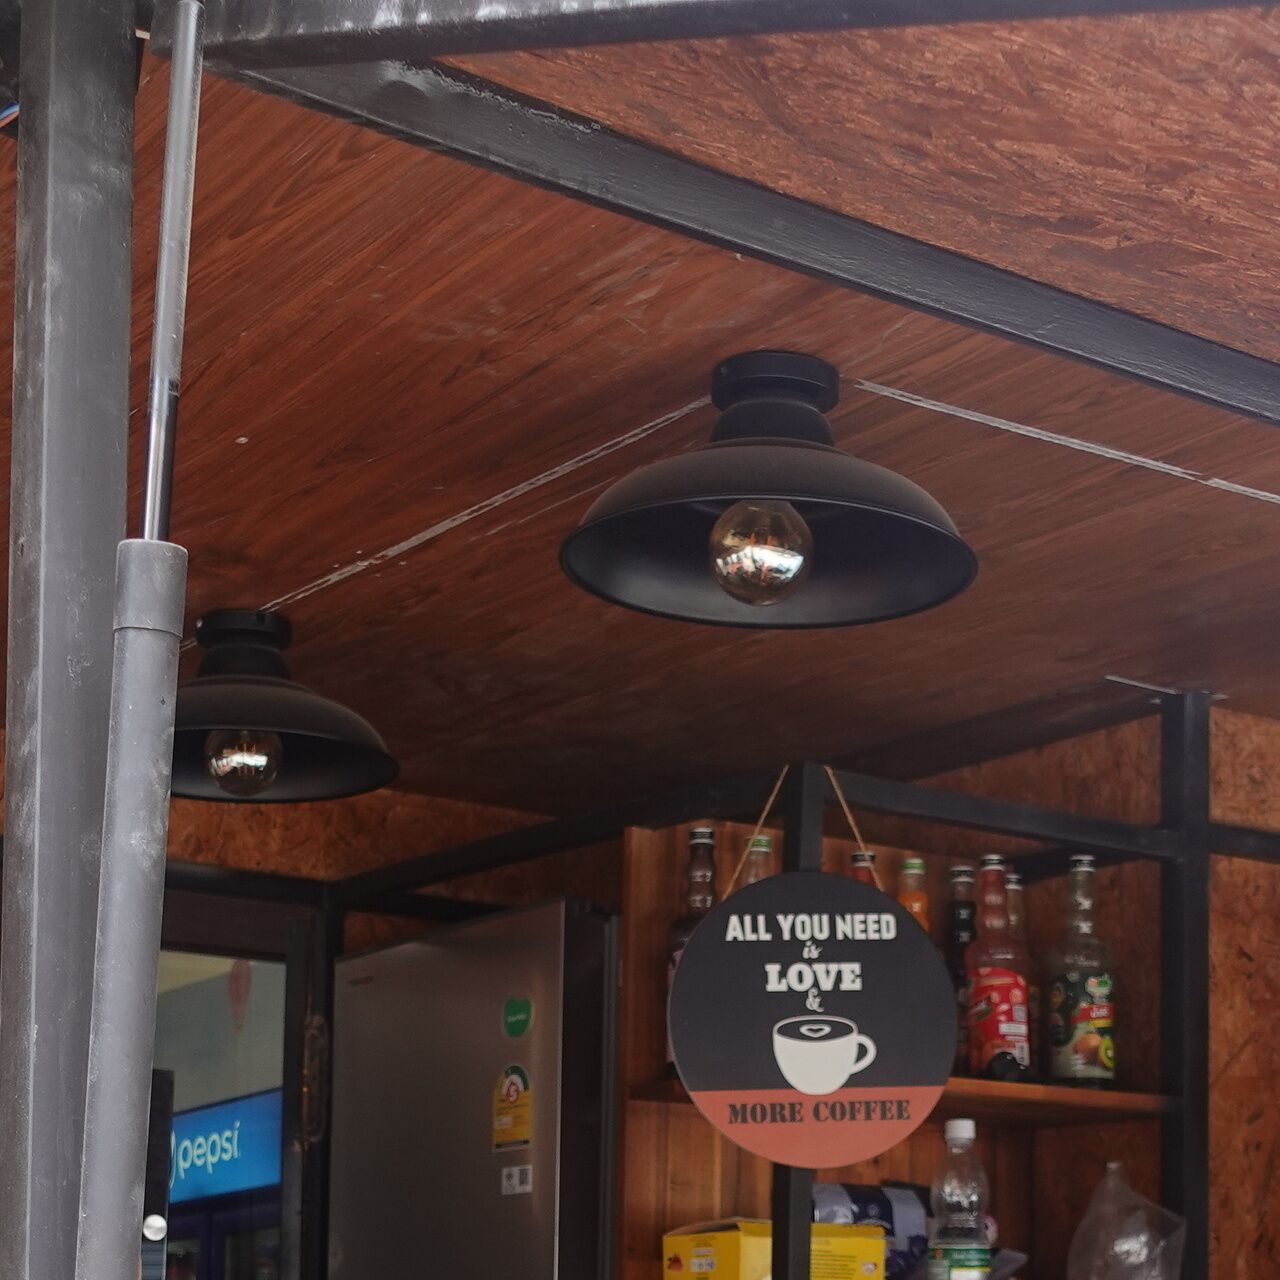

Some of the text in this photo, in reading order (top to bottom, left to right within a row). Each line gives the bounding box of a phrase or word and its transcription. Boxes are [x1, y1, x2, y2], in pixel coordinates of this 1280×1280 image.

[725, 912, 898, 942] ALL YOU NEED
[802, 940, 823, 960] is
[764, 962, 863, 993] LOVE
[805, 987, 825, 1013] &
[728, 1099, 911, 1125] MORE COFFEE
[177, 1120, 242, 1180] pepsi
